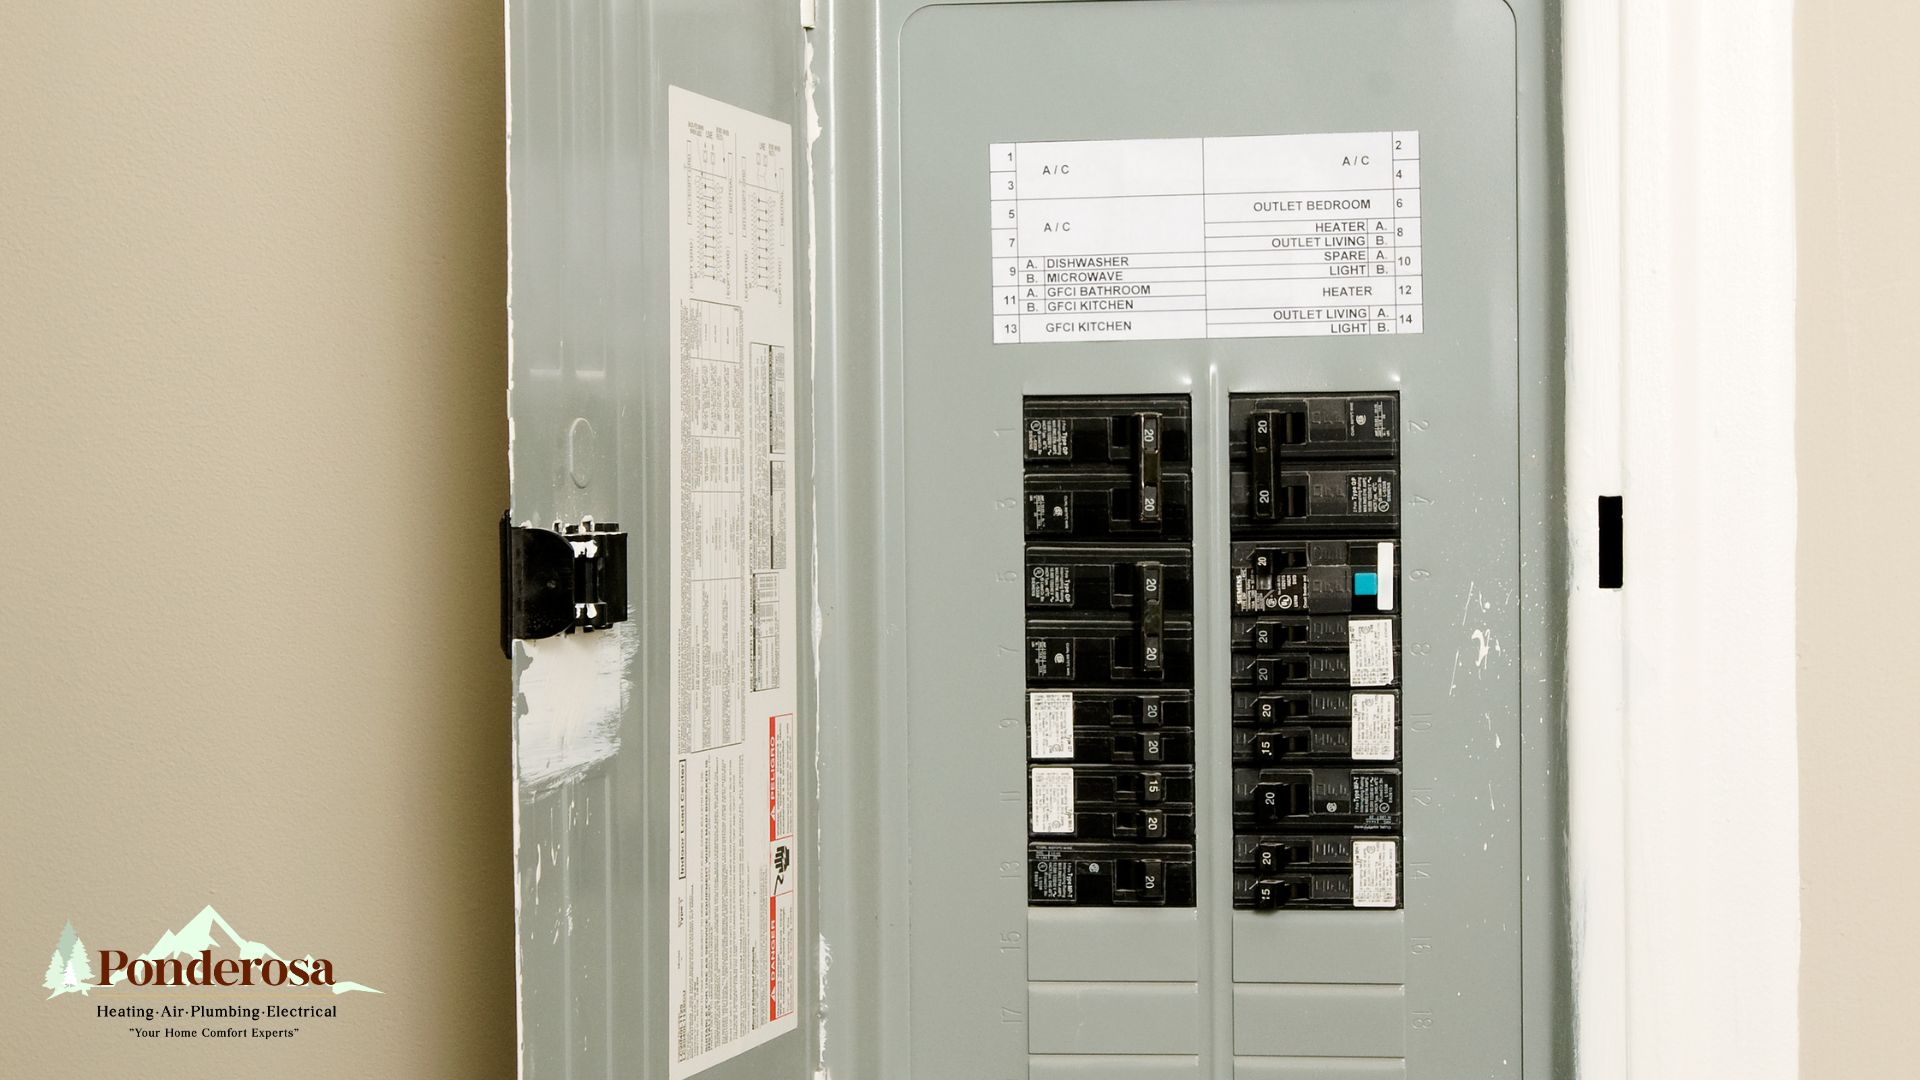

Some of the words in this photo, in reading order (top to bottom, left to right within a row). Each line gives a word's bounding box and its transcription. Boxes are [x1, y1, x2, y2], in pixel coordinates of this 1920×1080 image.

[1396, 141, 1401, 149] 2
[1007, 153, 1013, 161] 1
[1396, 170, 1401, 178] 4
[1008, 181, 1014, 190] 3
[1254, 201, 1302, 211] OUTLET
[1307, 200, 1370, 210] BEDROOM
[1397, 199, 1402, 207] 6
[1009, 210, 1014, 218] 5
[1316, 222, 1364, 232] HEATER
[1376, 221, 1386, 230] A.
[1397, 228, 1403, 236] 8
[1010, 238, 1015, 247] 7
[1272, 238, 1320, 247] OUTLET
[1326, 237, 1365, 246] LIVING
[1376, 236, 1386, 245] B.
[1325, 251, 1365, 260] SPARE
[1376, 250, 1386, 259] A.
[1027, 260, 1037, 268] A.
[1048, 257, 1128, 268] DISHWASHER
[1398, 257, 1410, 265] 10
[1010, 267, 1016, 276] 9
[1330, 265, 1365, 275] LIGHT
[1377, 265, 1387, 274] B.
[1027, 274, 1037, 283] B.
[1048, 272, 1121, 282] MICROWAVE
[1027, 288, 1037, 297] A.
[1048, 287, 1075, 297] GFCI
[1081, 285, 1150, 296] BATHROOM
[1323, 287, 1371, 296] HEATER
[1400, 285, 1411, 294] 12
[1005, 296, 1015, 304] 11
[1027, 303, 1037, 311] B.
[1048, 302, 1076, 311] GFCI
[1081, 300, 1133, 310] KITCHEN
[1274, 310, 1322, 320] OUTLET
[1327, 309, 1366, 318] LIVING
[1378, 308, 1388, 317] A.
[1401, 315, 1412, 323] 14
[1005, 324, 1017, 333] 13
[1046, 323, 1074, 332] GFCI
[1079, 322, 1131, 331] KITCHEN
[1331, 323, 1366, 333] LIGHT
[1378, 323, 1388, 332] B.
[1258, 420, 1267, 434] 20
[1144, 430, 1154, 442] 20
[1260, 490, 1269, 503] 20
[1145, 498, 1154, 511] 20
[1258, 557, 1266, 566] 20
[1146, 578, 1156, 592] 20
[1259, 630, 1268, 643] 20
[1147, 648, 1156, 660] 20
[1259, 668, 1268, 680] 20
[1148, 705, 1157, 718] 20
[1262, 704, 1271, 717] 20
[1149, 740, 1158, 754] 20
[1149, 780, 1159, 792] 15
[1266, 792, 1274, 805] 20
[1148, 818, 1157, 830] 20
[1262, 852, 1271, 865] 20
[1146, 876, 1154, 888] 20
